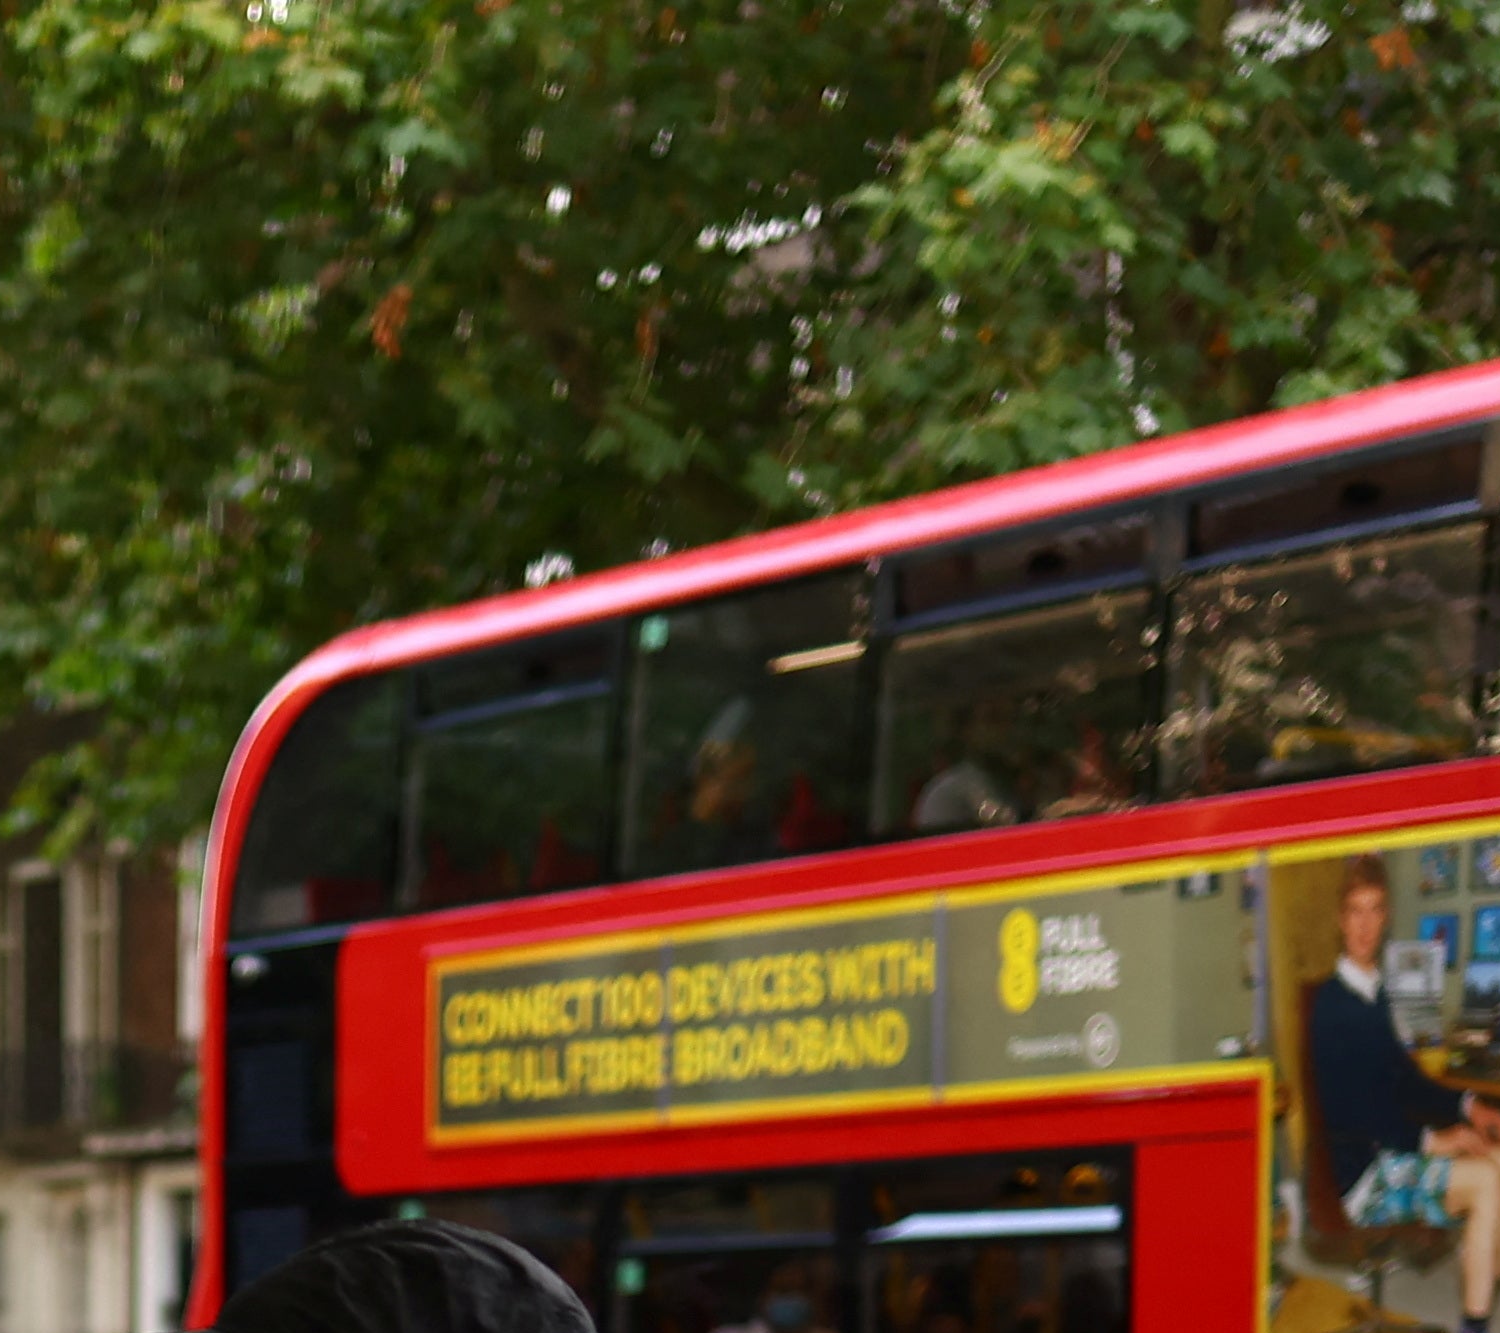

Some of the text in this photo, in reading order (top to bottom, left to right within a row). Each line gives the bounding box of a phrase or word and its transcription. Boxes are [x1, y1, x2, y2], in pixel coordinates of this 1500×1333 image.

[1041, 912, 1107, 954] FULL
[444, 977, 596, 1047] CONNECT
[602, 970, 663, 1030] 100
[666, 949, 825, 1024] DEVICES
[827, 937, 937, 1003] WITH
[566, 1033, 665, 1097] FIBRE
[671, 1007, 909, 1087] BROADBAND
